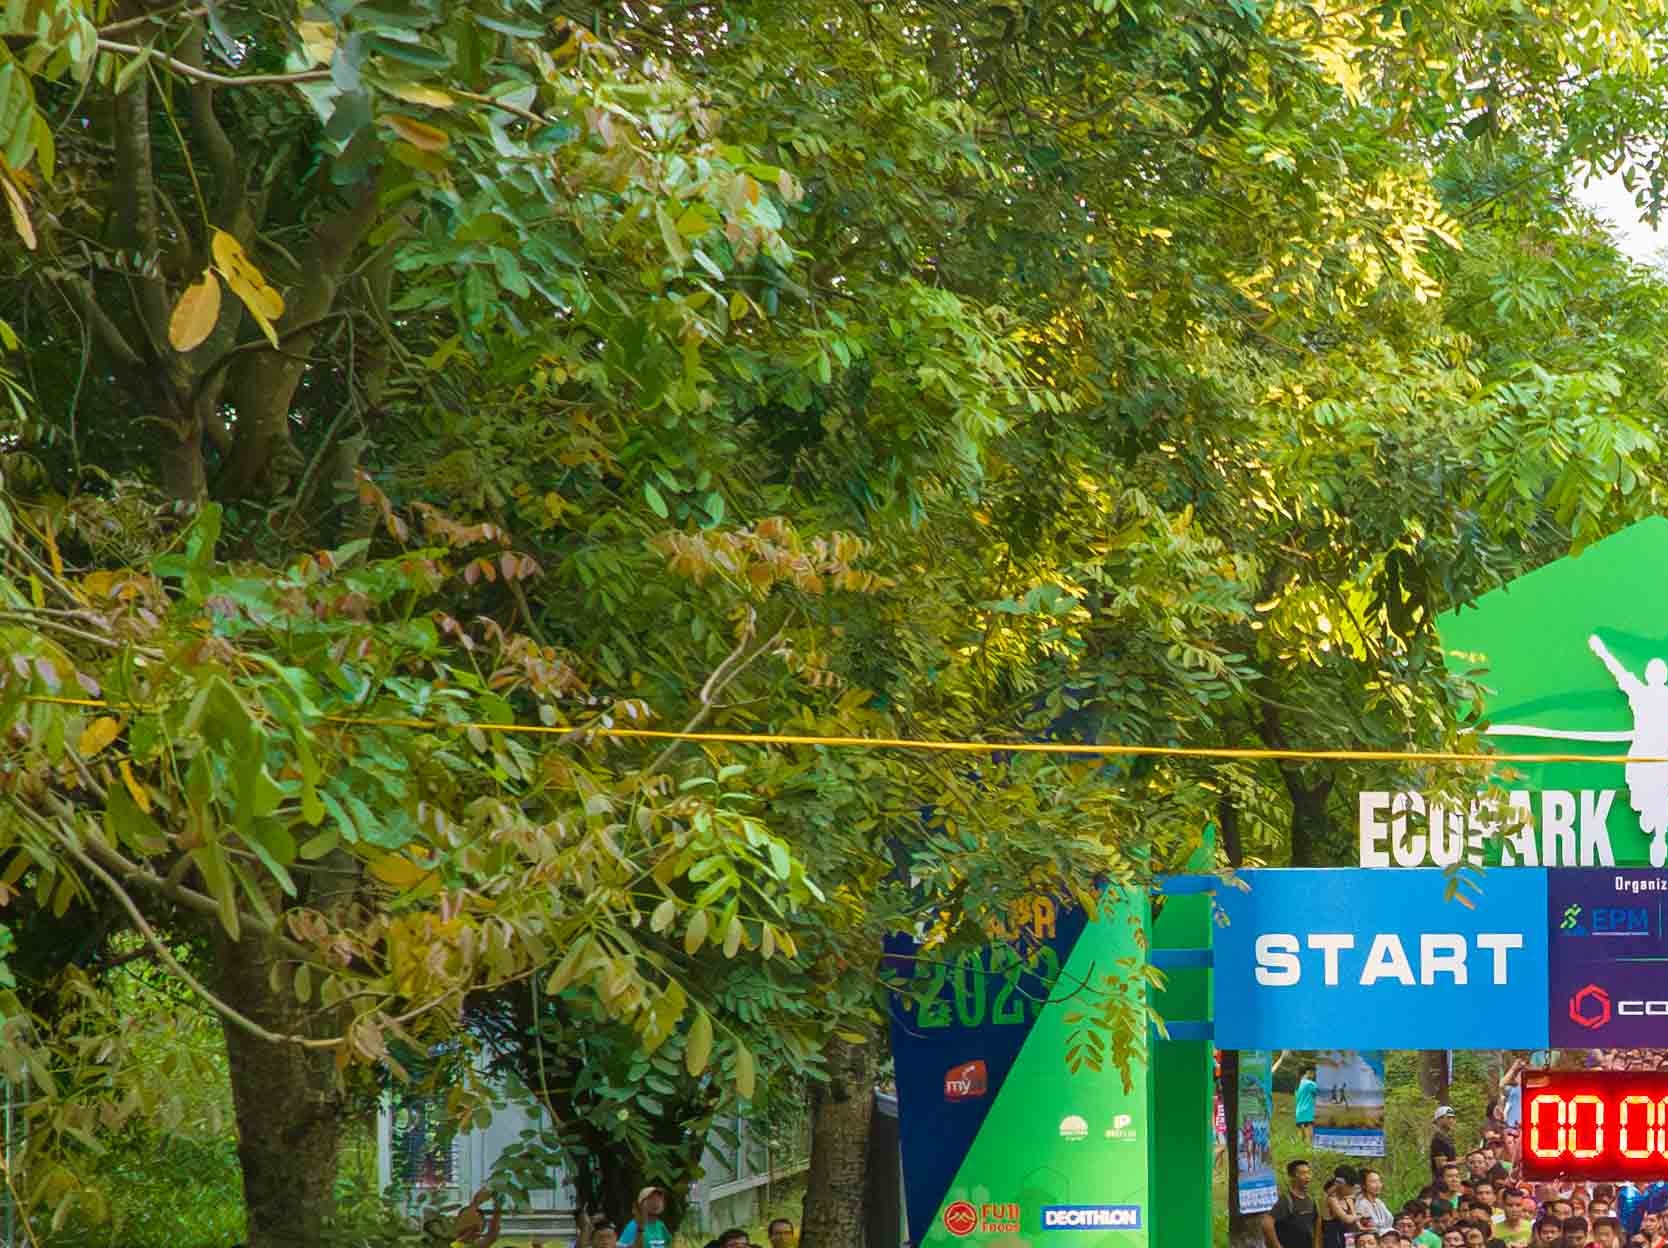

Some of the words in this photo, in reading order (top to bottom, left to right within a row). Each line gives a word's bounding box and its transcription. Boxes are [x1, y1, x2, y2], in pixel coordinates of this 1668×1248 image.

[1359, 790, 1617, 868] ECOPARK
[1592, 908, 1648, 929] EPM
[1255, 933, 1523, 986] START
[1531, 1094, 1604, 1158] 00
[1045, 1209, 1137, 1226] DECATHLON
